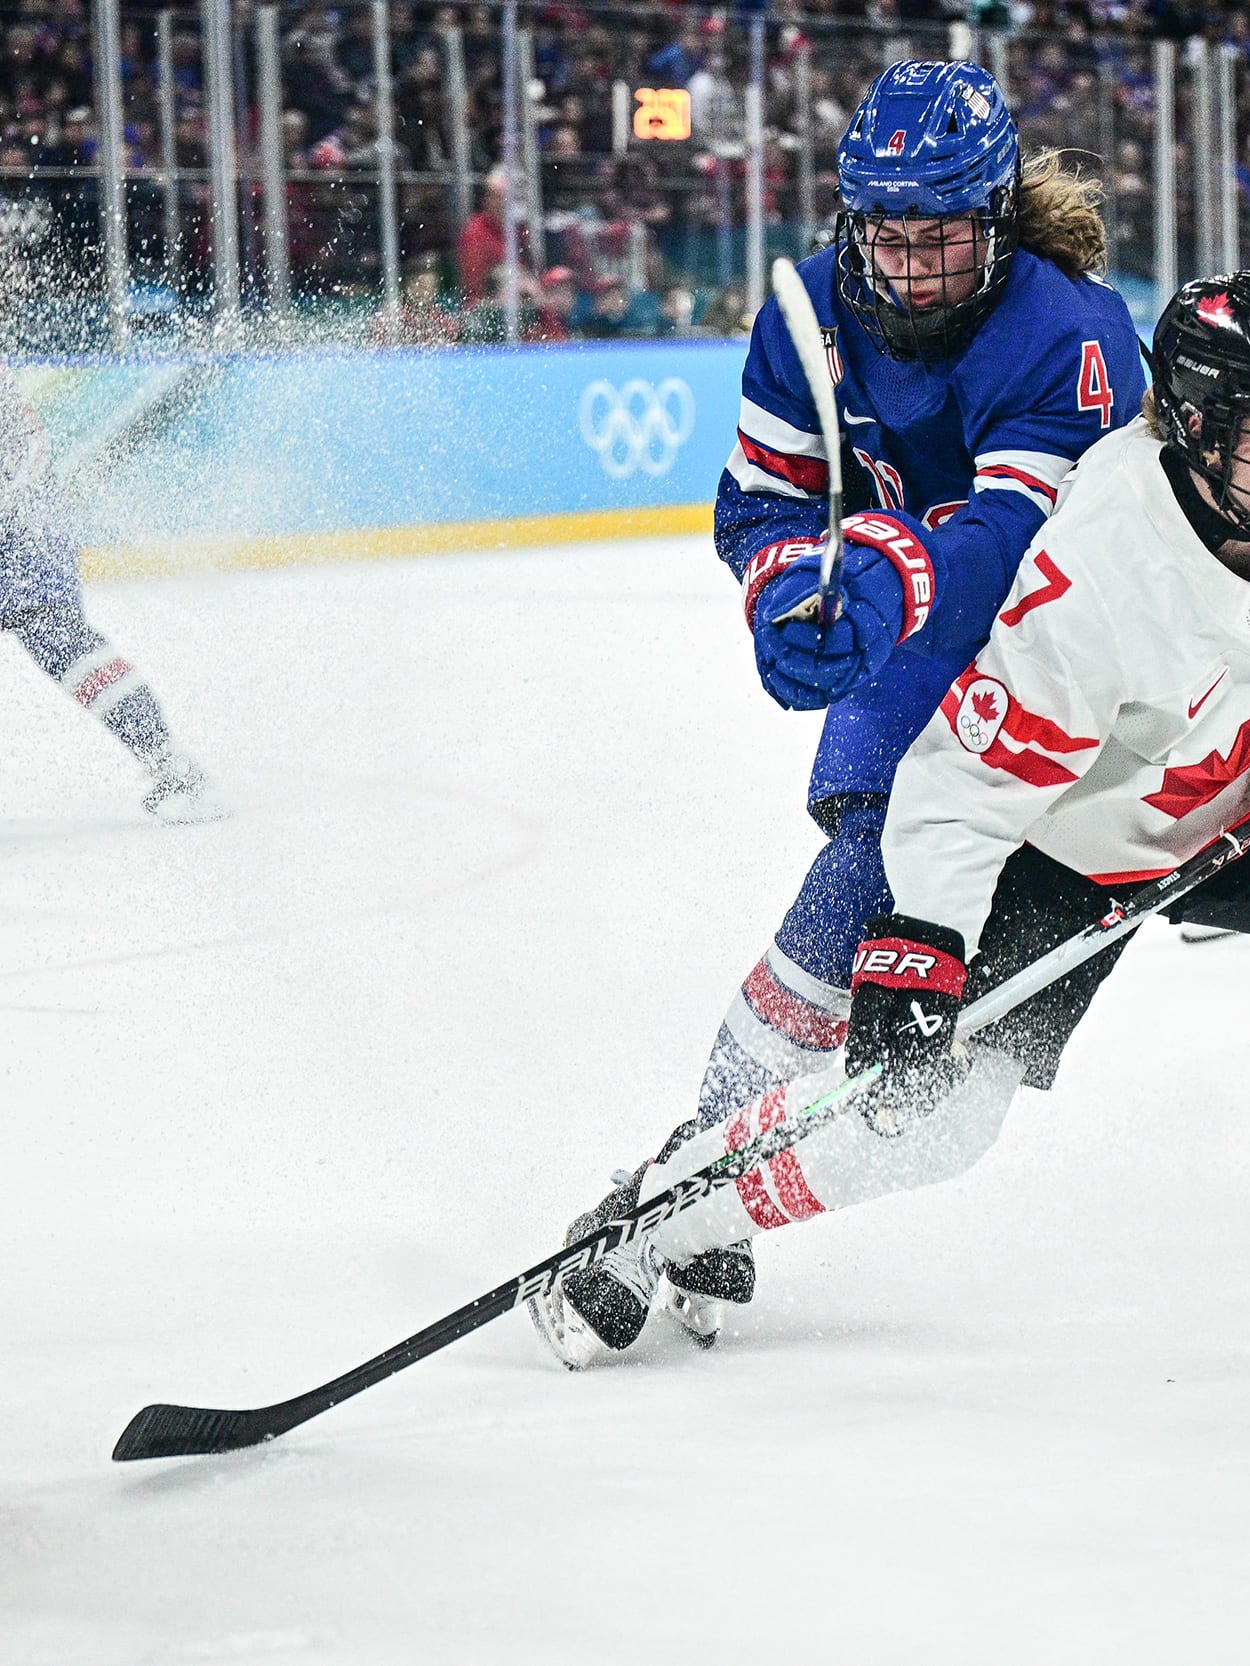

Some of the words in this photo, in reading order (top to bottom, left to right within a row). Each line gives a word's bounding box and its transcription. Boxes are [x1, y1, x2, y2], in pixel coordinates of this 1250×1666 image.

[889, 130, 906, 154] 4
[819, 332, 832, 346] SA
[1078, 340, 1114, 429] 4
[1000, 549, 1073, 628] 7
[851, 949, 936, 978] UER
